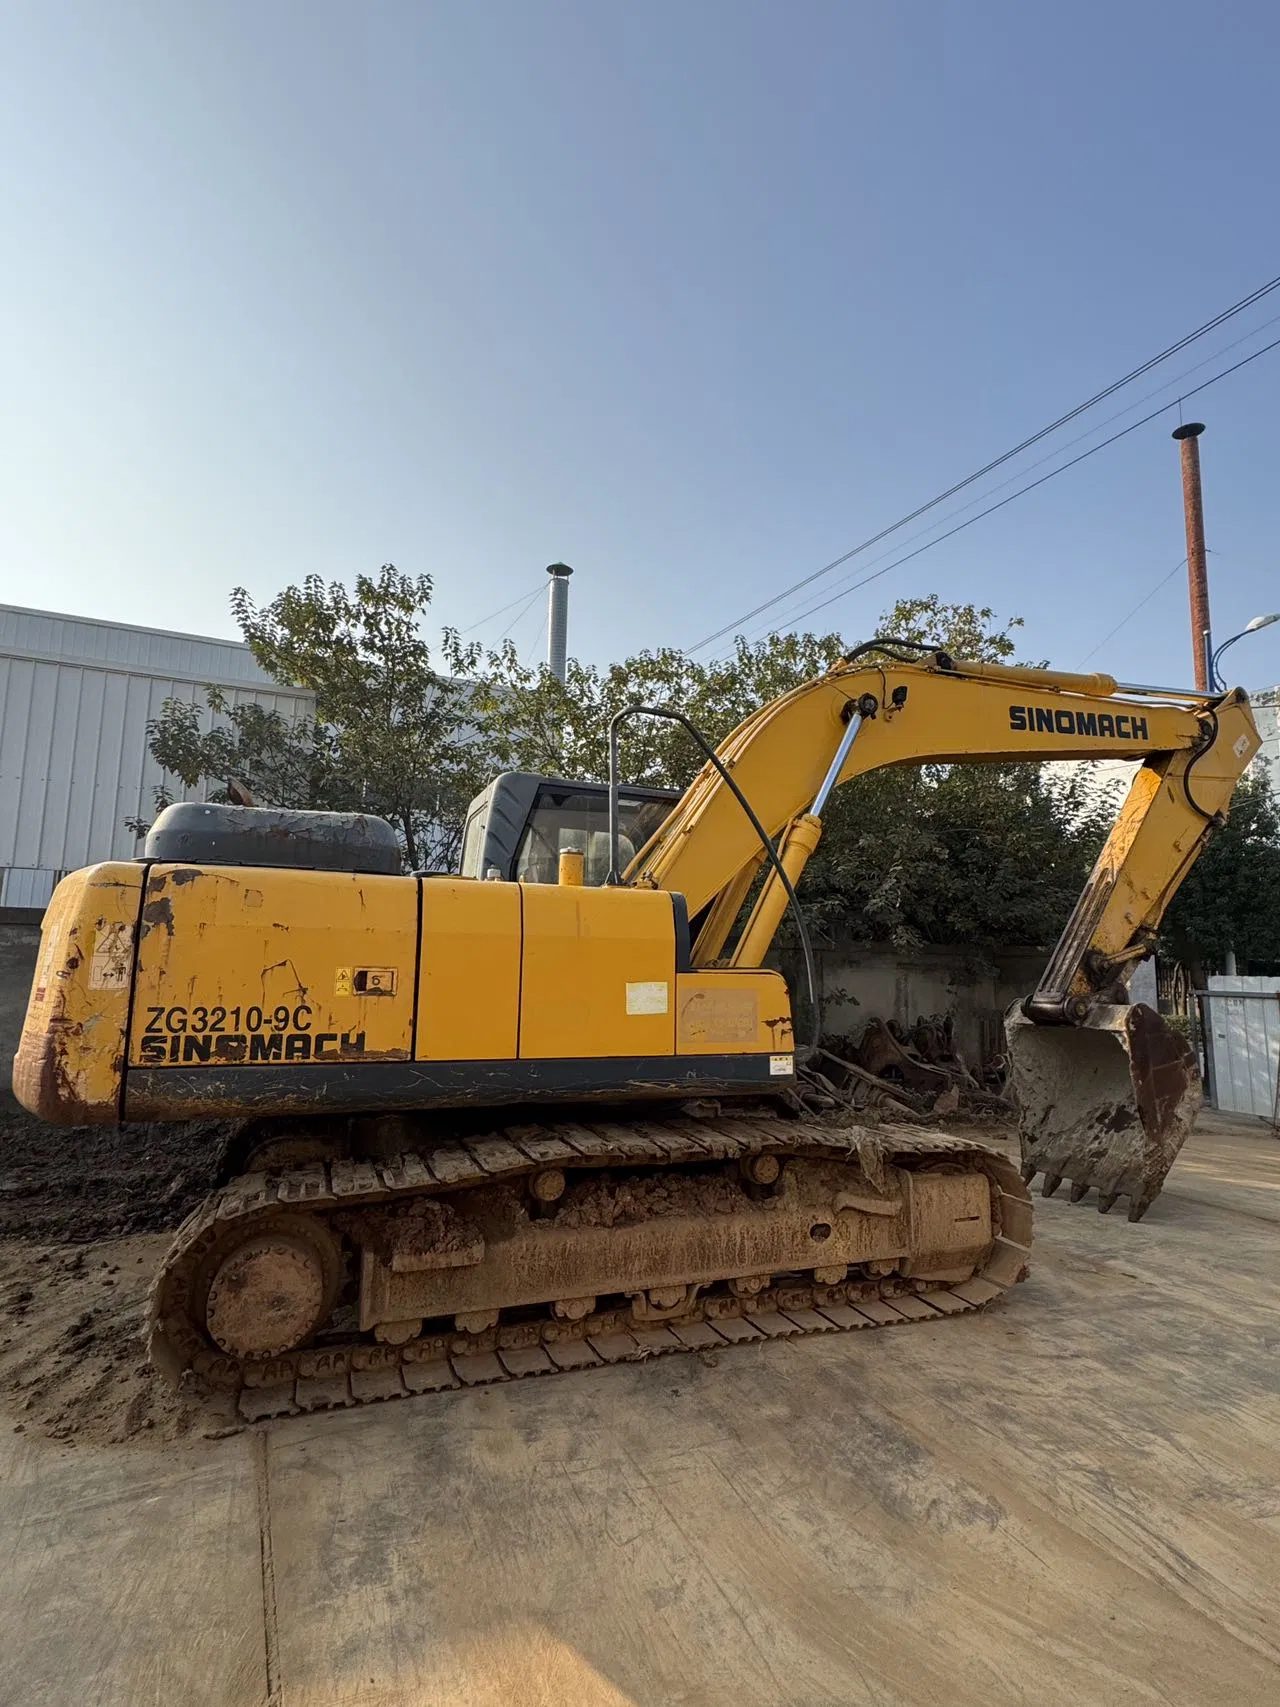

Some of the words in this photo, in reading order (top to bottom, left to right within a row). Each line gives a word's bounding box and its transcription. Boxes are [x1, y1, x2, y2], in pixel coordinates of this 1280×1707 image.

[1009, 705, 1148, 739] SINOMACH
[145, 1006, 312, 1033] ZG3210-9C
[140, 1032, 366, 1063] SINOMACH
